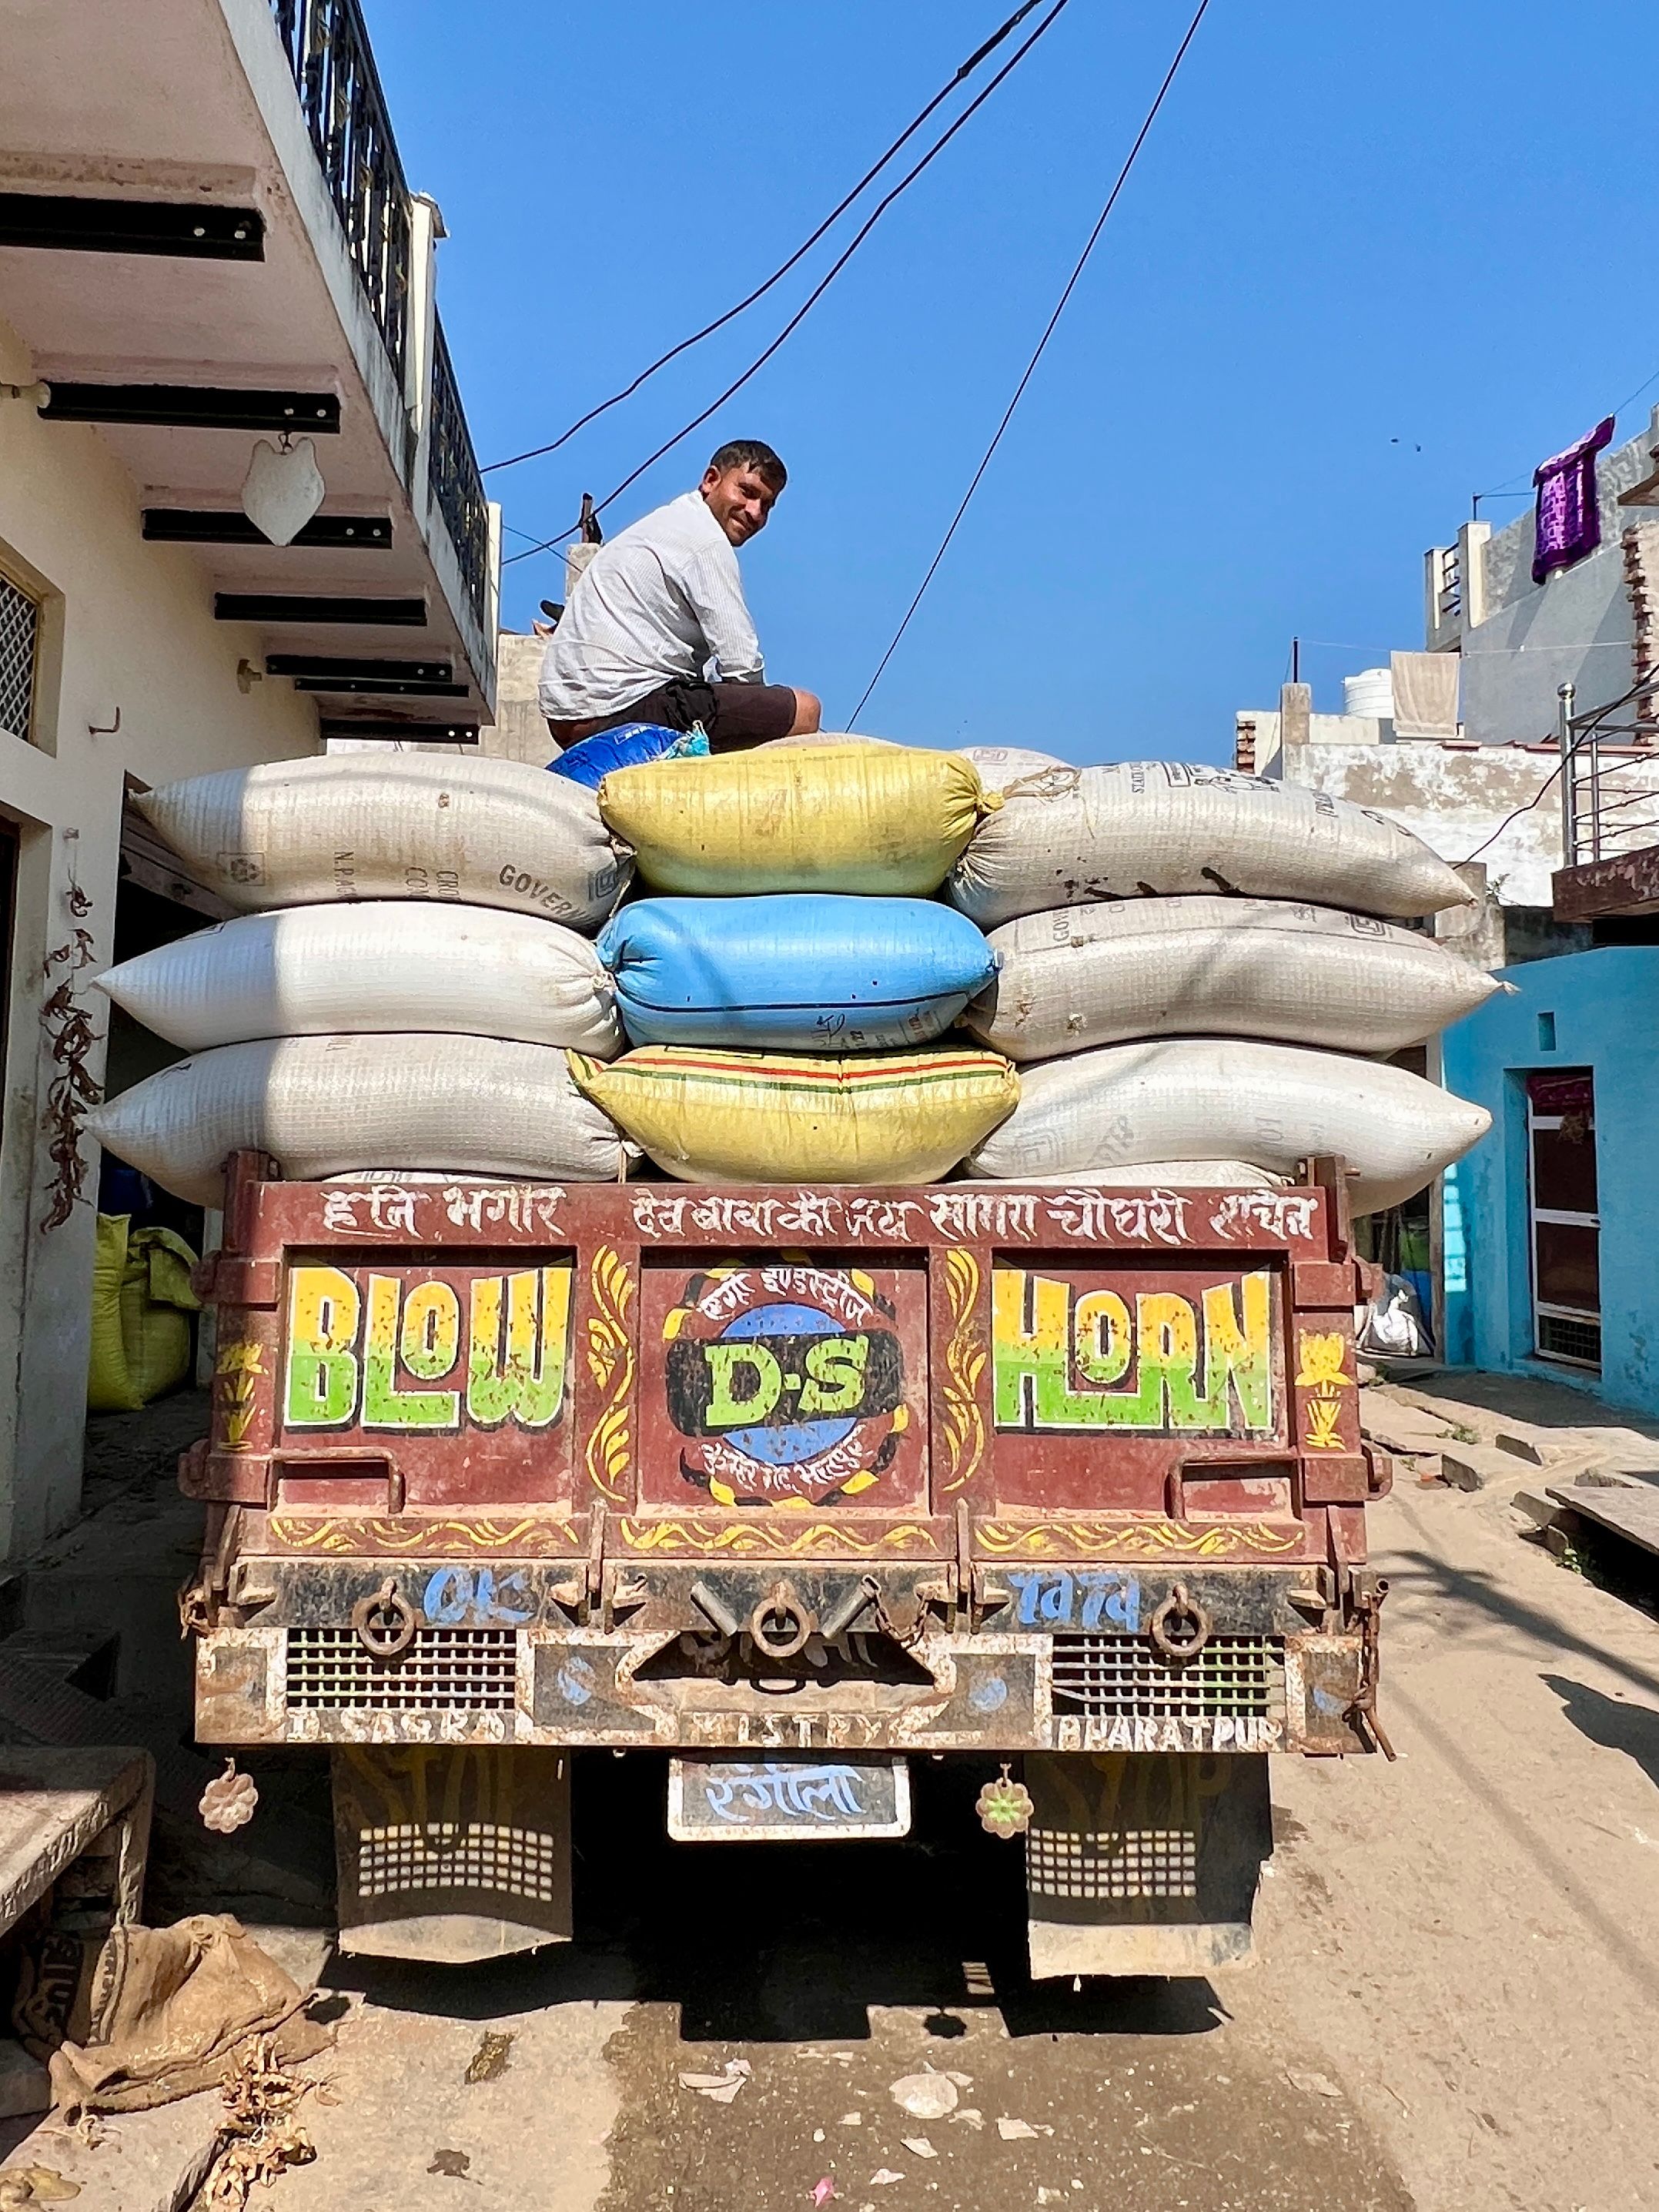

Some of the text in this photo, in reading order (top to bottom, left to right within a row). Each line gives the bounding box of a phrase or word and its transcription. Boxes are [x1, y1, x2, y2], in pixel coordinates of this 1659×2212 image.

[283, 1264, 1275, 1431] BLOW HORN
[1059, 1715, 1284, 1753] BHARATPUR
